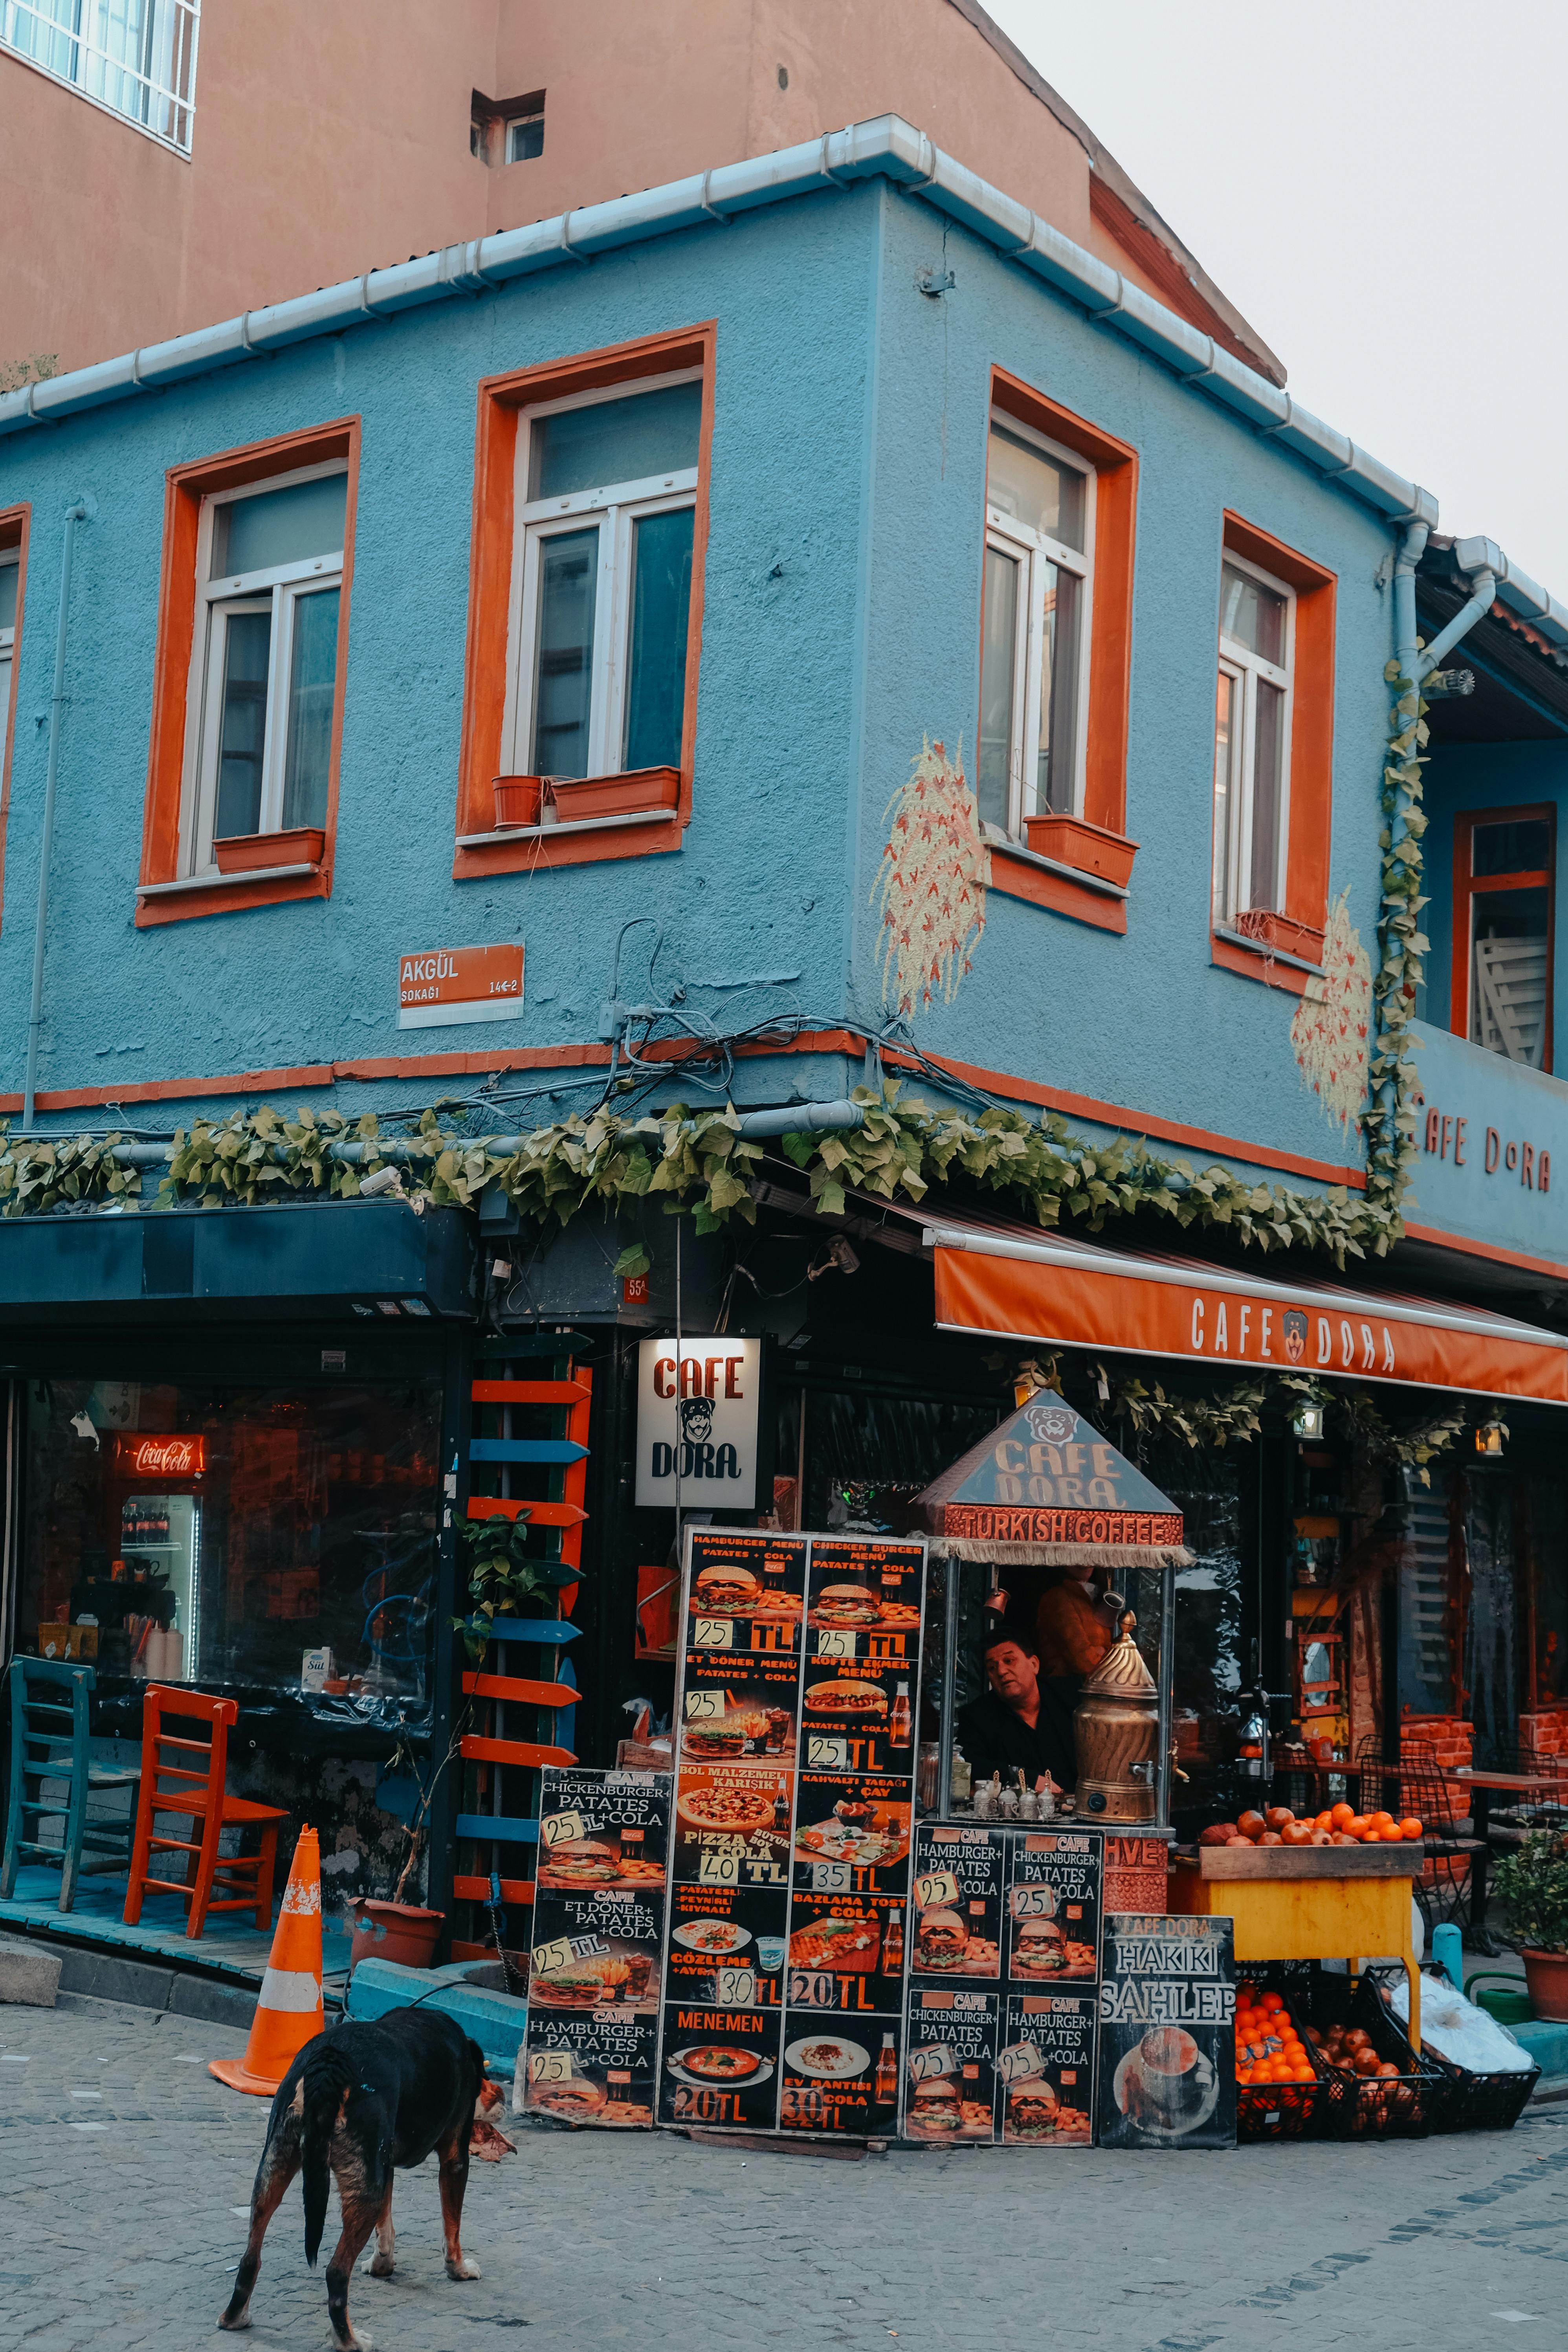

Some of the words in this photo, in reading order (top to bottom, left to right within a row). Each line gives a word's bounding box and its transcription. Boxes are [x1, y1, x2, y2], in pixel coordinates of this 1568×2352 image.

[402, 953, 459, 983] AKGÜL
[401, 986, 439, 1002] SOKAĞI
[490, 982, 501, 993] 14
[511, 979, 518, 991] 2
[1191, 1298, 1273, 1356] CAFE
[1317, 1317, 1395, 1372] DORA
[654, 1356, 744, 1399] CAFE
[136, 1441, 194, 1471] Coca-Cola
[652, 1442, 742, 1479] DORA
[994, 1439, 1122, 1478] CAFE
[995, 1473, 1127, 1508] DORA
[961, 1512, 1068, 1542] TURKISH
[1075, 1515, 1166, 1546] COFFEE
[693, 1536, 766, 1547] HAMBURGER
[772, 1540, 804, 1549] MENÜ
[812, 1541, 867, 1551] CHICKEN
[872, 1545, 922, 1555] BURGER
[702, 1548, 749, 1558] PATATES
[850, 1552, 886, 1561] MENÜ
[812, 1560, 865, 1570] PATATES
[882, 1564, 915, 1573] COLA
[696, 1620, 727, 1647] 25
[754, 1622, 791, 1650] TL
[819, 1631, 846, 1657] 25
[871, 1636, 905, 1659] TL
[686, 1655, 704, 1663] ET
[709, 1655, 755, 1667] DÖNER
[760, 1659, 798, 1669] MENÜ
[863, 1659, 910, 1670] EKMEK
[697, 1669, 748, 1679] PATATES
[765, 1673, 797, 1682] COLA
[837, 1666, 882, 1678] MENÜ
[688, 1693, 718, 1718] 25
[801, 1722, 847, 1730] PATATES
[809, 1739, 842, 1764] 25
[848, 1739, 884, 1770] TL
[607, 1772, 655, 1787] CAFE
[679, 1766, 705, 1776] BOL
[713, 1777, 775, 1791] KARIŞIK
[802, 1774, 859, 1785] KAHVALTI
[864, 1778, 907, 1787] TABAĞI
[860, 1787, 891, 1798] ÇAY
[558, 1794, 649, 1812] PATATES
[547, 1814, 574, 1845] 25
[684, 1829, 747, 1847] PİZZA
[960, 1829, 989, 1845] CAFE
[749, 1836, 774, 1849] BOY
[1057, 1836, 1090, 1853] CAFE
[717, 1846, 773, 1860] COLA
[704, 1857, 734, 1880] 40
[746, 1861, 788, 1883] TL
[928, 1858, 991, 1877] PATATES
[1024, 1865, 1086, 1884] PATATES
[817, 1864, 845, 1887] 35
[853, 1866, 882, 1892] TL
[594, 1891, 635, 1903] CAFE
[922, 1875, 947, 1907] 25
[564, 1901, 585, 1912] ET
[793, 1893, 863, 1906] BAZLAMA
[870, 1897, 907, 1908] TOST
[1017, 1890, 1045, 1916] 25
[576, 1912, 654, 1928] PATATES
[830, 1906, 879, 1919] COLA
[1166, 1918, 1210, 1937] DORA
[536, 1940, 565, 1975] 25
[569, 1934, 611, 1959] TL
[670, 1952, 751, 1968] GÖZLEME
[722, 1972, 752, 2004] 30
[756, 1978, 782, 2004] TL
[791, 1975, 831, 2005] 20
[836, 1974, 875, 2009] TL
[954, 1993, 987, 2011] CAFE
[1051, 1998, 1080, 2013] CAFE
[1100, 1975, 1236, 2025] SAHLEP
[592, 2011, 635, 2024] CAFE
[678, 2011, 763, 2033] MENEMEN
[920, 2024, 983, 2042] PATATES
[1020, 2027, 1082, 2047] PATATES
[546, 2034, 638, 2052] PATATES
[534, 2055, 565, 2084] 25
[914, 2047, 943, 2081] 25
[1003, 2047, 1030, 2082] 25
[784, 2077, 804, 2087] EV
[675, 2087, 715, 2118] 20
[716, 2093, 747, 2121] TL
[823, 2094, 867, 2106] COLA
[782, 2090, 822, 2120] 30
[822, 2105, 845, 2129] TL
